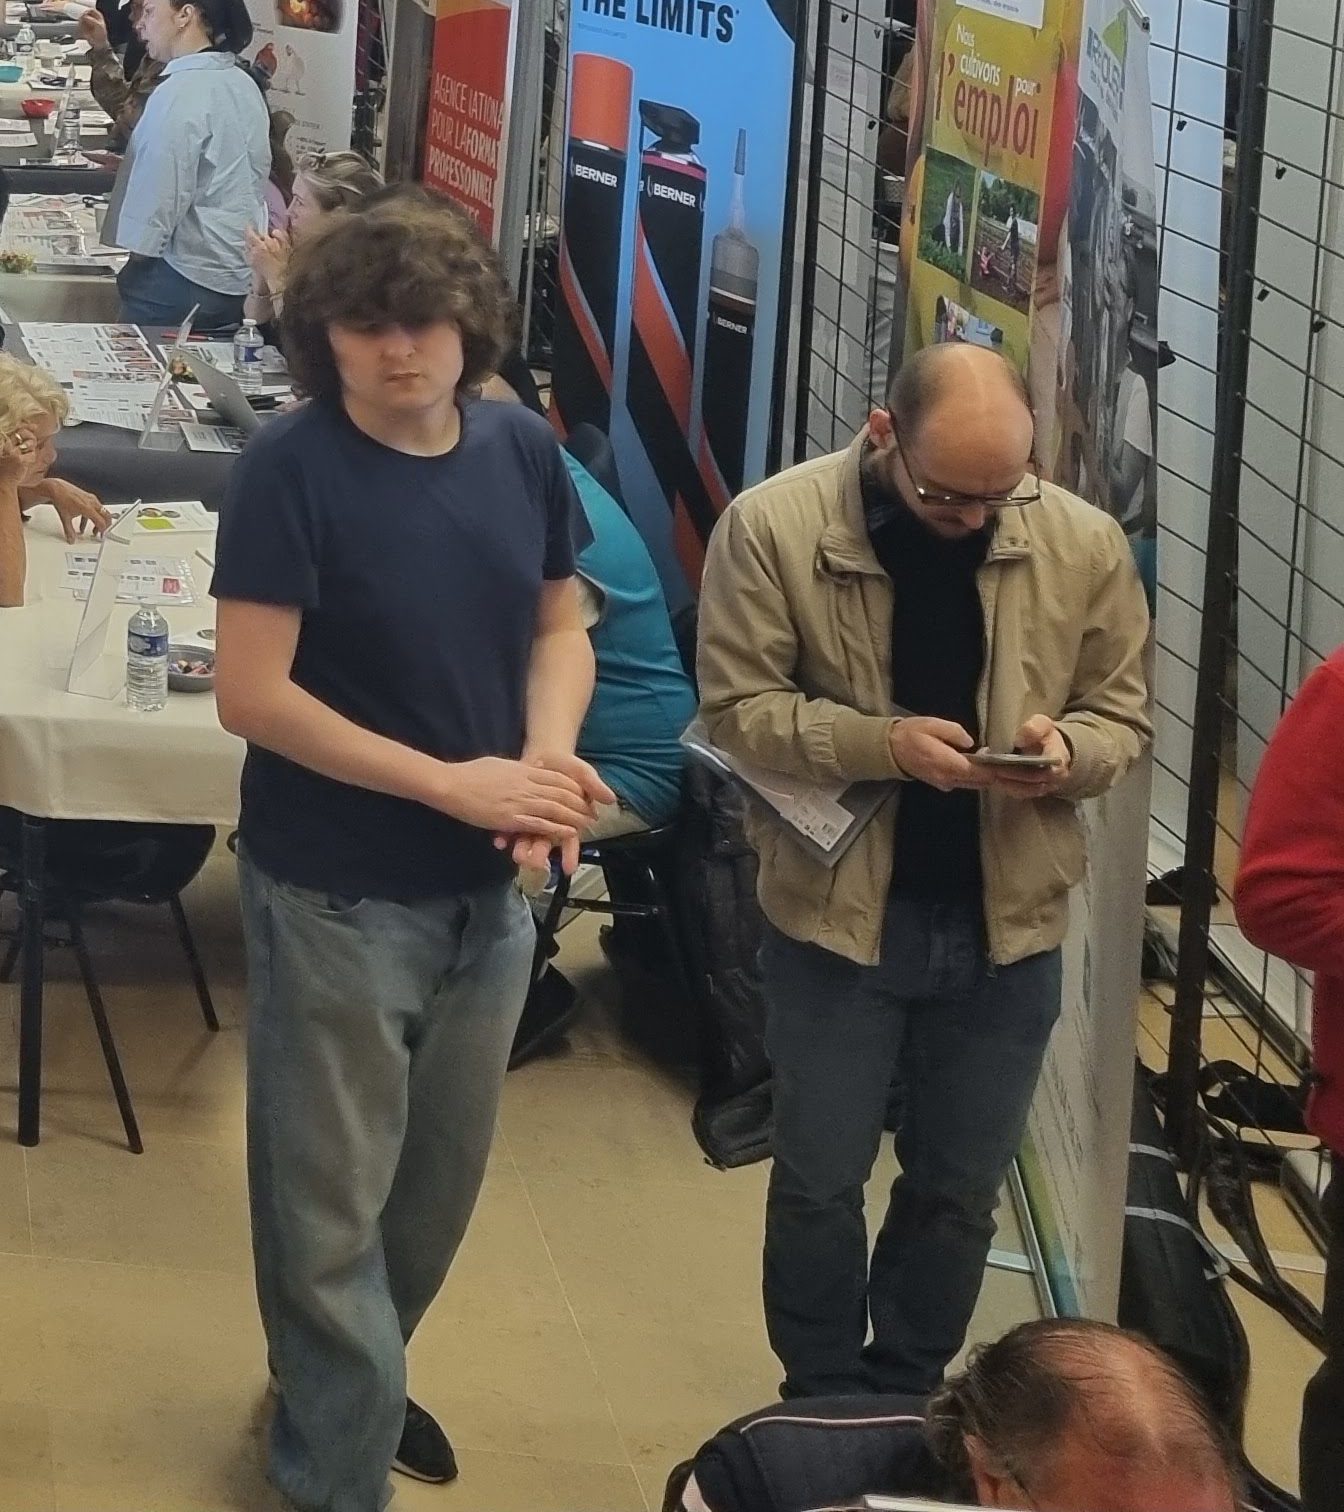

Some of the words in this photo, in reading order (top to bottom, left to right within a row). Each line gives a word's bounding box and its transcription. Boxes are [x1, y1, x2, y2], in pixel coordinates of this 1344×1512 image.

[957, 23, 975, 47] Nous
[960, 49, 1001, 86] cultivons
[1015, 77, 1037, 97] pour
[434, 72, 468, 114] AGENCE
[468, 89, 506, 130] ATIONA
[936, 52, 1041, 167] l'emploi
[432, 109, 454, 145] POUR
[466, 133, 501, 170] FORMAT
[428, 146, 495, 209] PROFESSONNEL
[575, 164, 618, 188] BERNER
[653, 183, 696, 207] BERNER
[717, 316, 748, 336] BERNER
